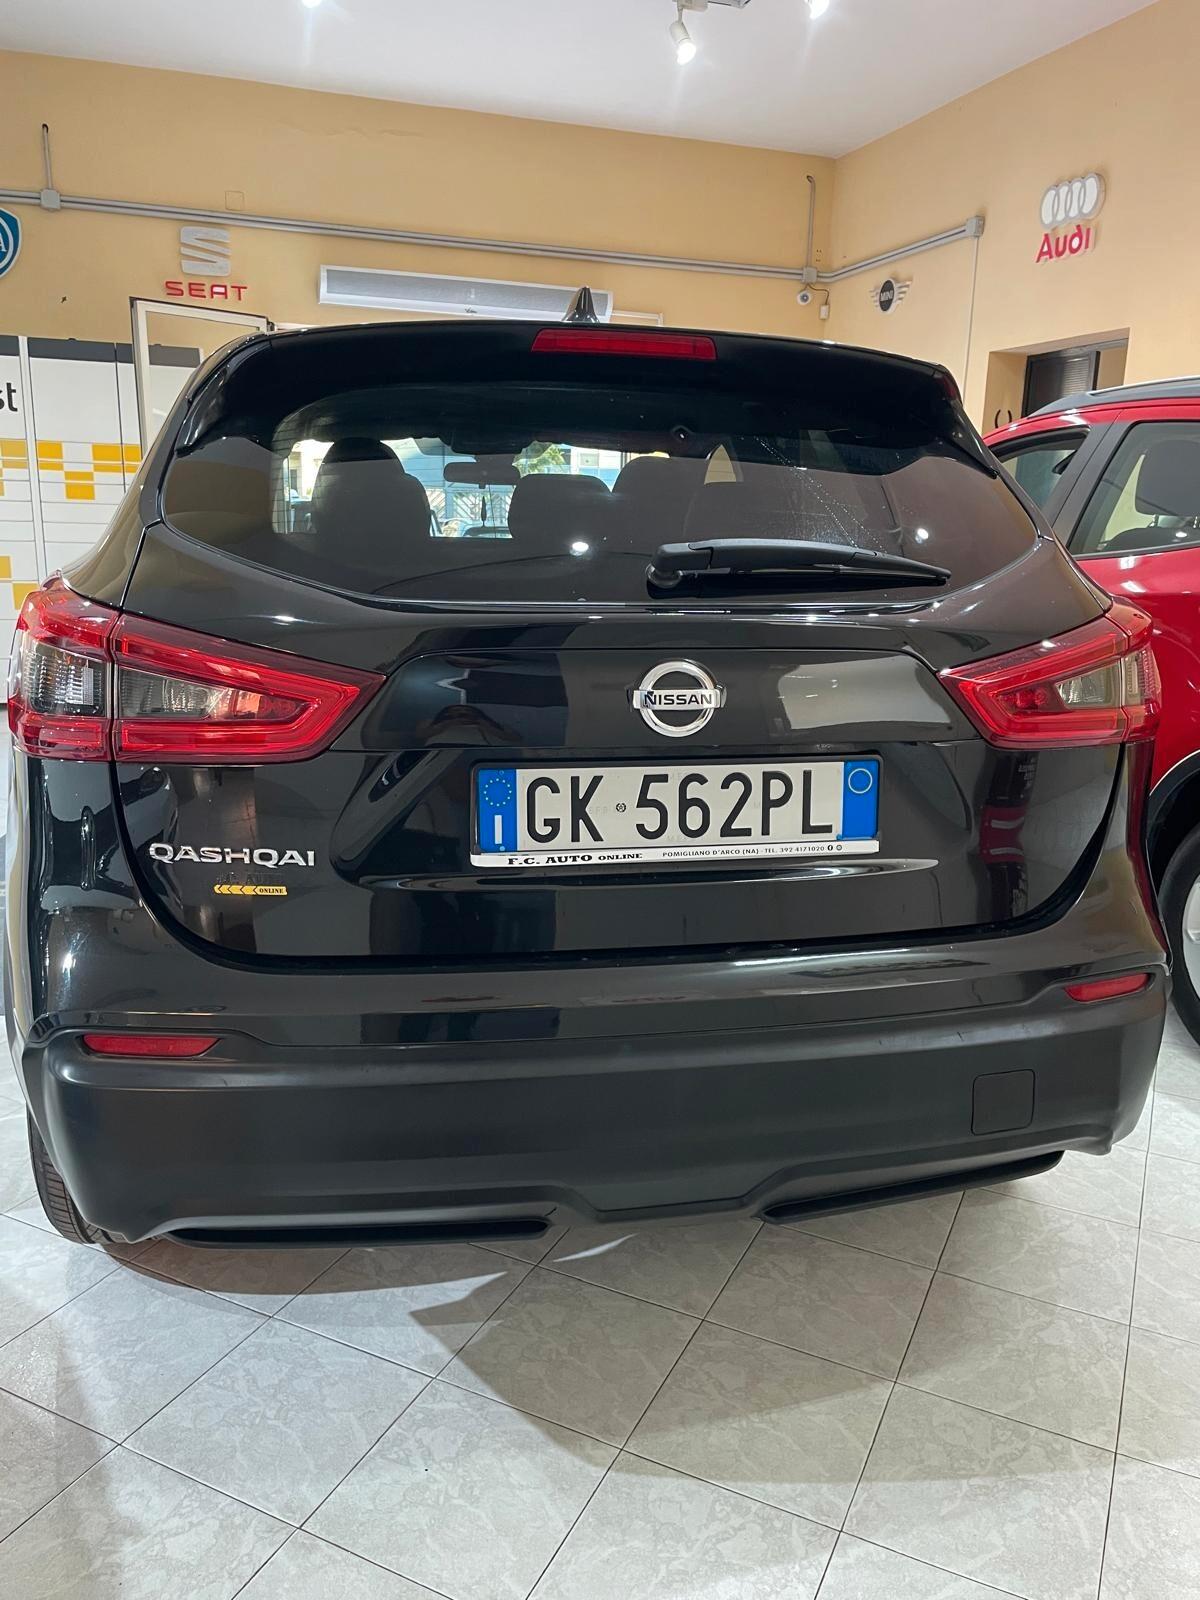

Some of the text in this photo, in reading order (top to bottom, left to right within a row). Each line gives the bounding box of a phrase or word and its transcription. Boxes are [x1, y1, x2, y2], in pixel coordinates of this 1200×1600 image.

[1036, 224, 1091, 263] Audi
[165, 281, 248, 301] SEAT
[880, 290, 894, 301] MINI
[644, 694, 712, 705] NISSAN
[526, 769, 833, 843] GK 562PL
[149, 843, 315, 869] QASHQAI
[508, 853, 643, 865] F.C. AUTO ONLINE
